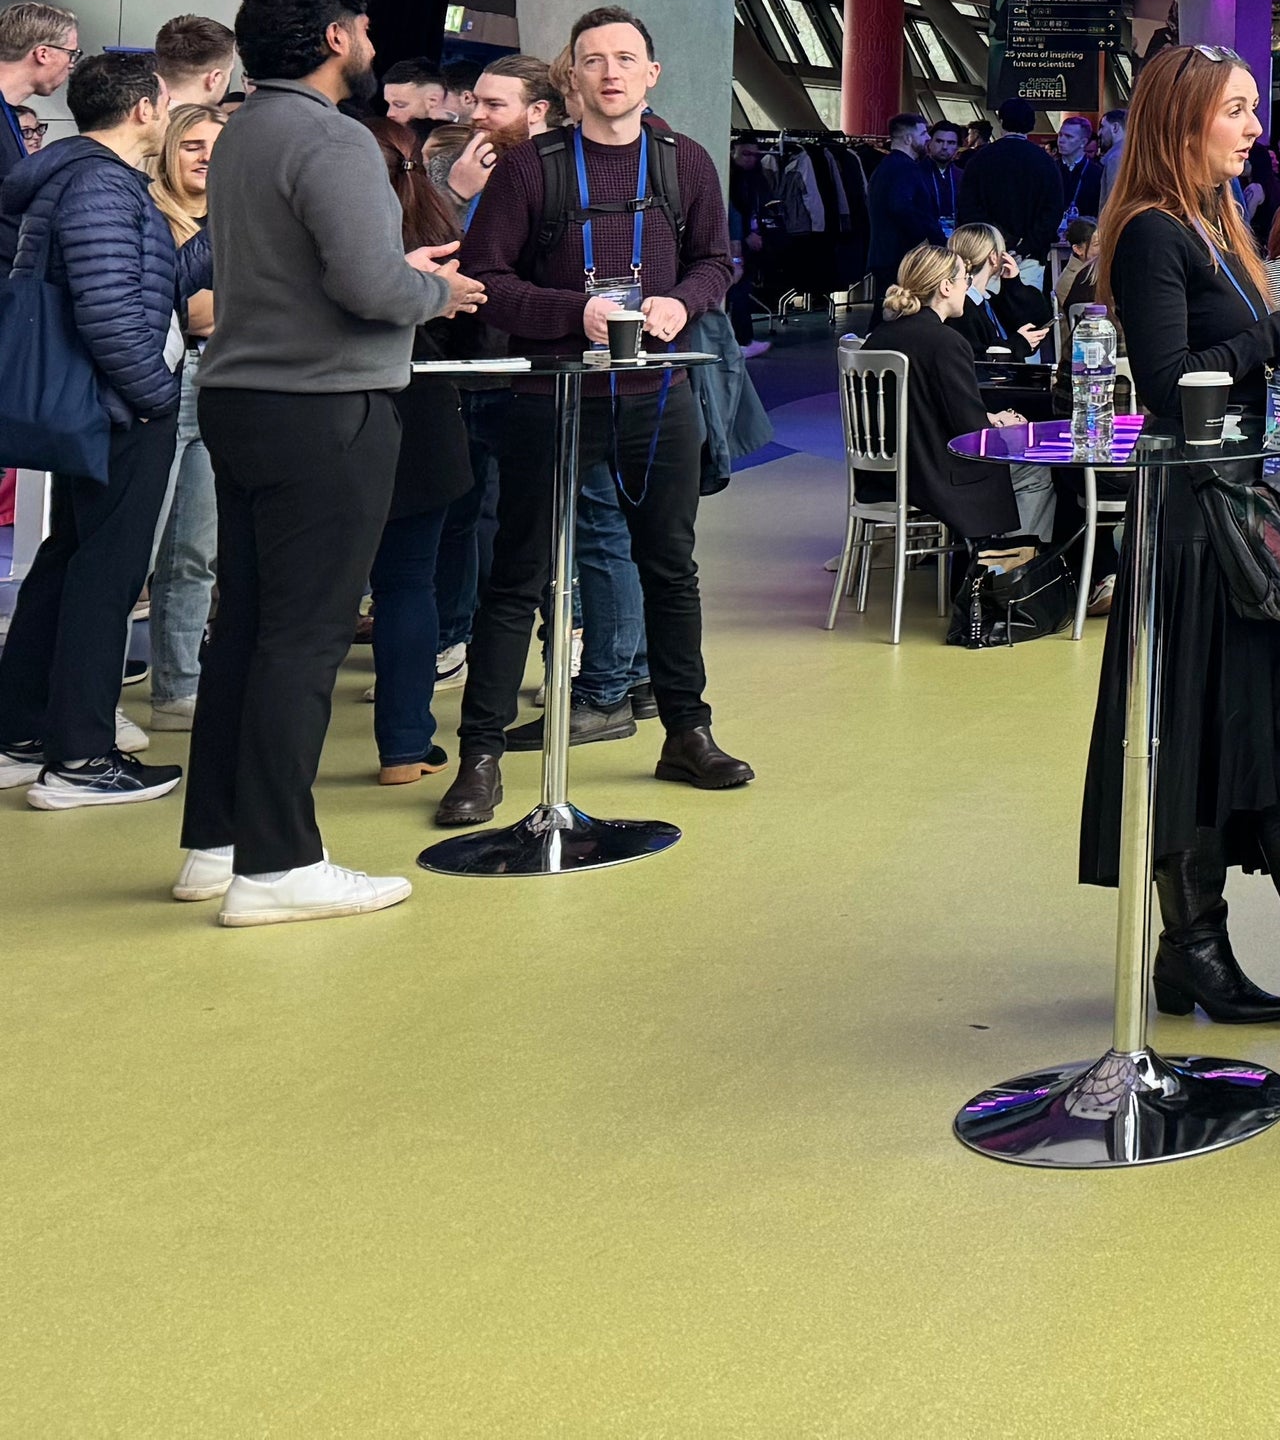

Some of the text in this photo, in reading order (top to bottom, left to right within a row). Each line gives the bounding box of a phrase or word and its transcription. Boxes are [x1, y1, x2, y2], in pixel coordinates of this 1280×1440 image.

[1005, 50, 1015, 58] 25
[1017, 51, 1039, 59] years
[1050, 51, 1084, 60] inspiring
[1012, 60, 1075, 68] future scientists
[1019, 81, 1062, 90] SCIENCE
[1018, 89, 1062, 98] CENTRE
